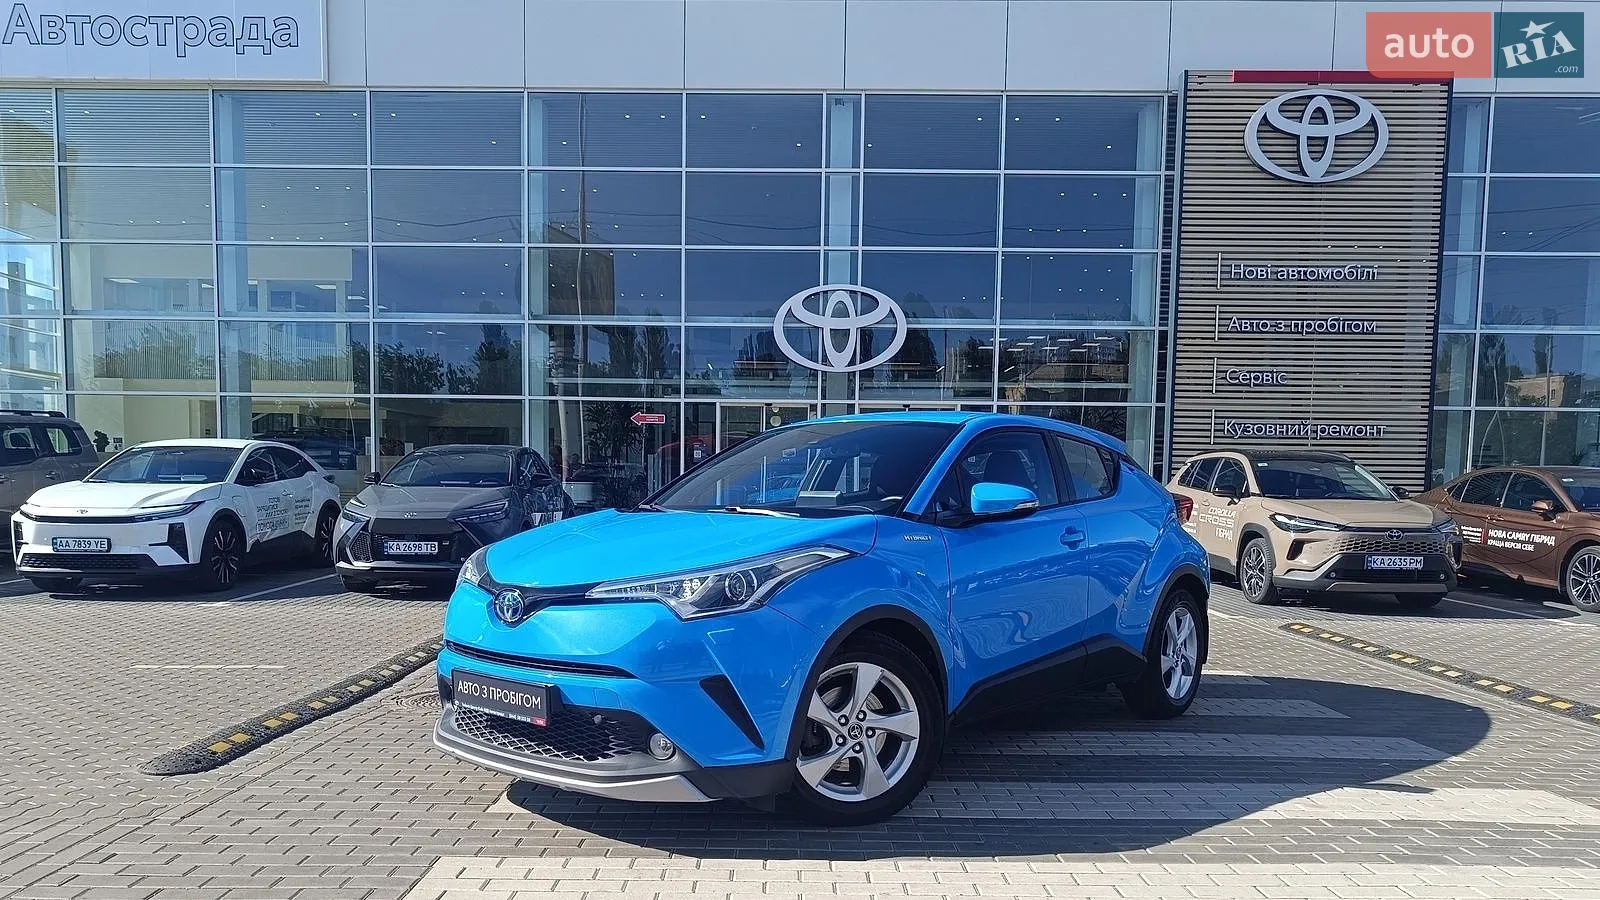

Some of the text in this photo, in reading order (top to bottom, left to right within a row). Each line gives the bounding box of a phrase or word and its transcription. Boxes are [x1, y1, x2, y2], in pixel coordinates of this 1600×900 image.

[2, 3, 299, 57] Автострада
[1230, 263, 1379, 281] Нові автомобілі
[1227, 315, 1377, 336] Авто з пробігом
[1226, 368, 1288, 387] Сервіс
[1223, 419, 1387, 440] Кузовний ремонт
[1198, 513, 1235, 528] CROSS
[1488, 528, 1507, 540] НОВА
[58, 540, 107, 549] AA 7839 YE
[388, 543, 437, 552] KA 2698 TB
[1372, 557, 1423, 568] KA 2635 PM
[457, 679, 480, 697] АВТО
[489, 686, 541, 710] ПРОБІГОМ
